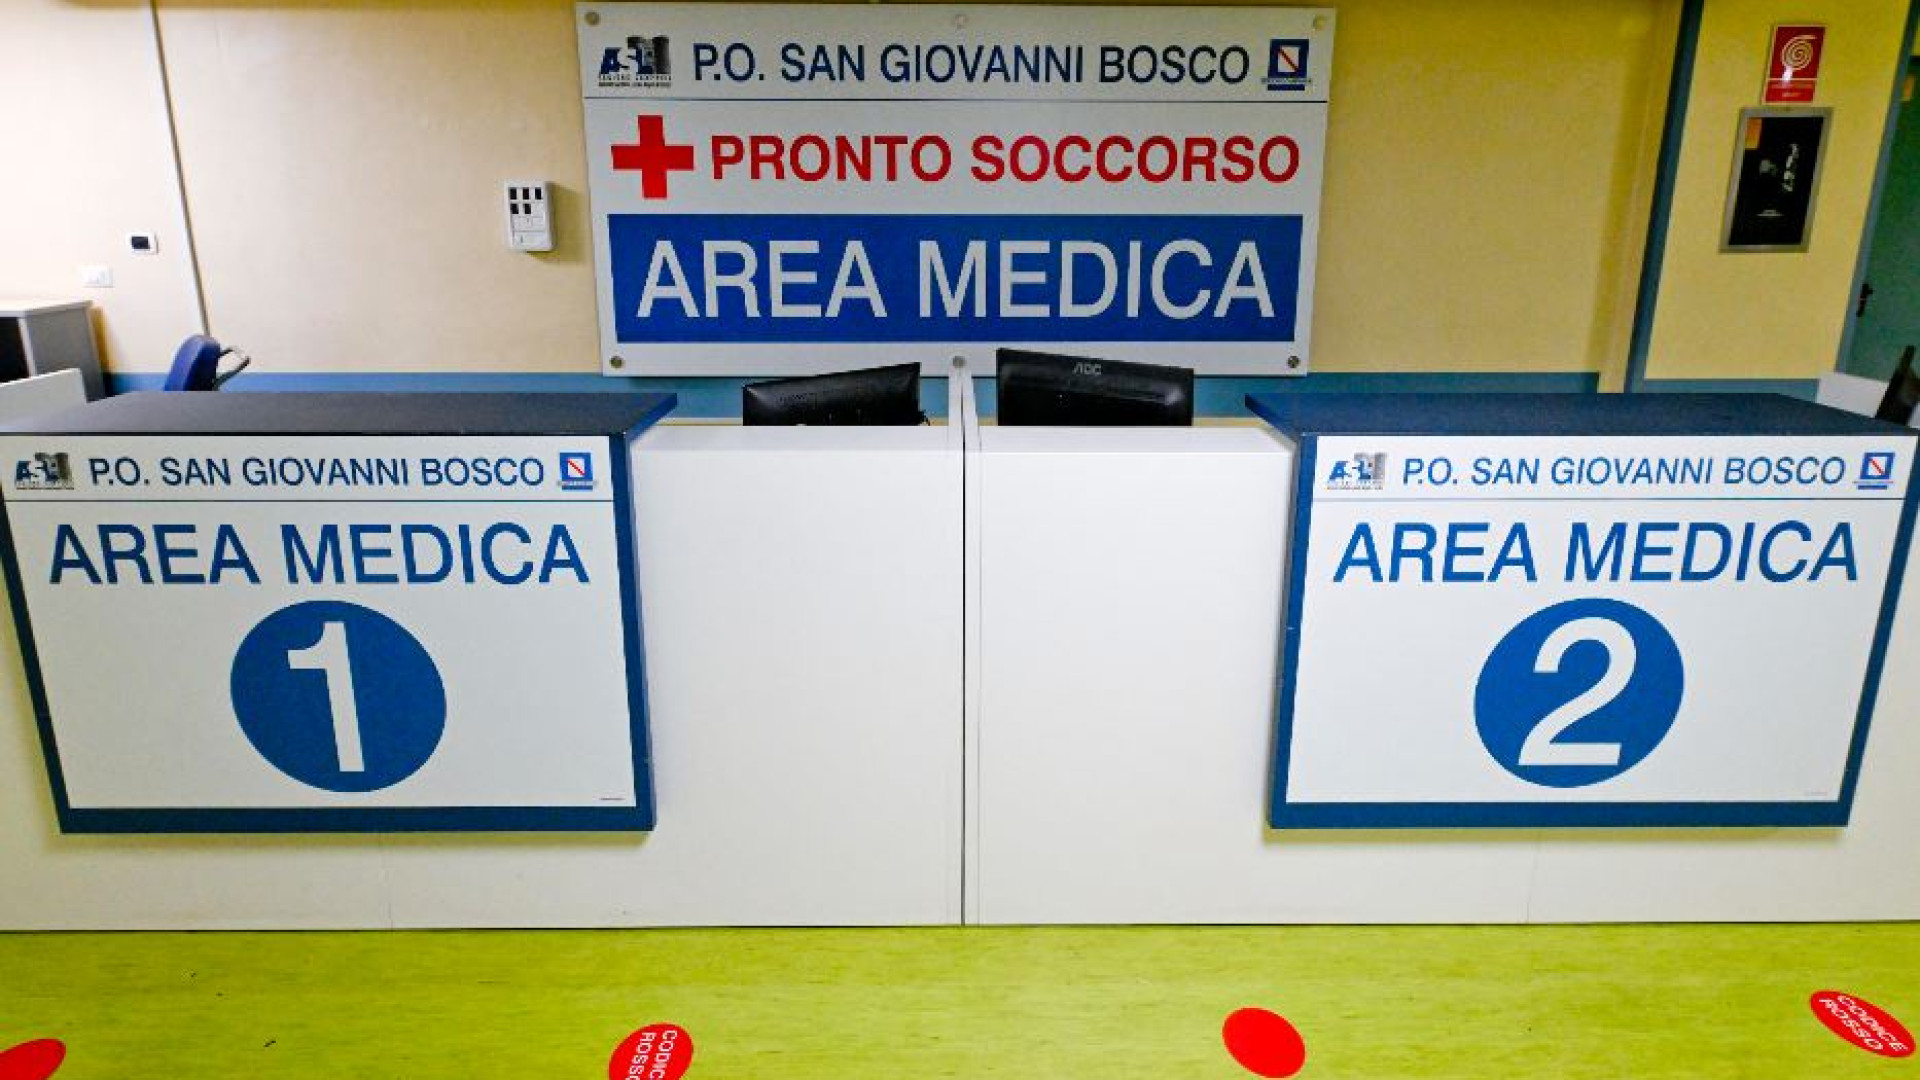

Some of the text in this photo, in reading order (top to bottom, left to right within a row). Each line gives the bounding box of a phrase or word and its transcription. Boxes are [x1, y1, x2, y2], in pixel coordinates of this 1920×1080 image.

[692, 42, 1250, 85] P.O. SAN GIOVANNI BOSCO
[711, 133, 1300, 184] PRONTO SOCCORSO
[637, 240, 1275, 318] AREA MEDICA
[88, 456, 545, 487] P.O. SAN GIOVANNI BOSCO
[1401, 456, 1846, 486] P.O. SAN GIOVANNI BOSCO
[48, 521, 590, 585] AREA MEDICA
[1333, 519, 1858, 583] AREA MEDICA
[286, 620, 366, 773] 1
[1517, 615, 1638, 768] 2
[1819, 998, 1884, 1049] ROSSO
[1837, 995, 1908, 1051] CODICE
[648, 1029, 678, 1080] CODIC
